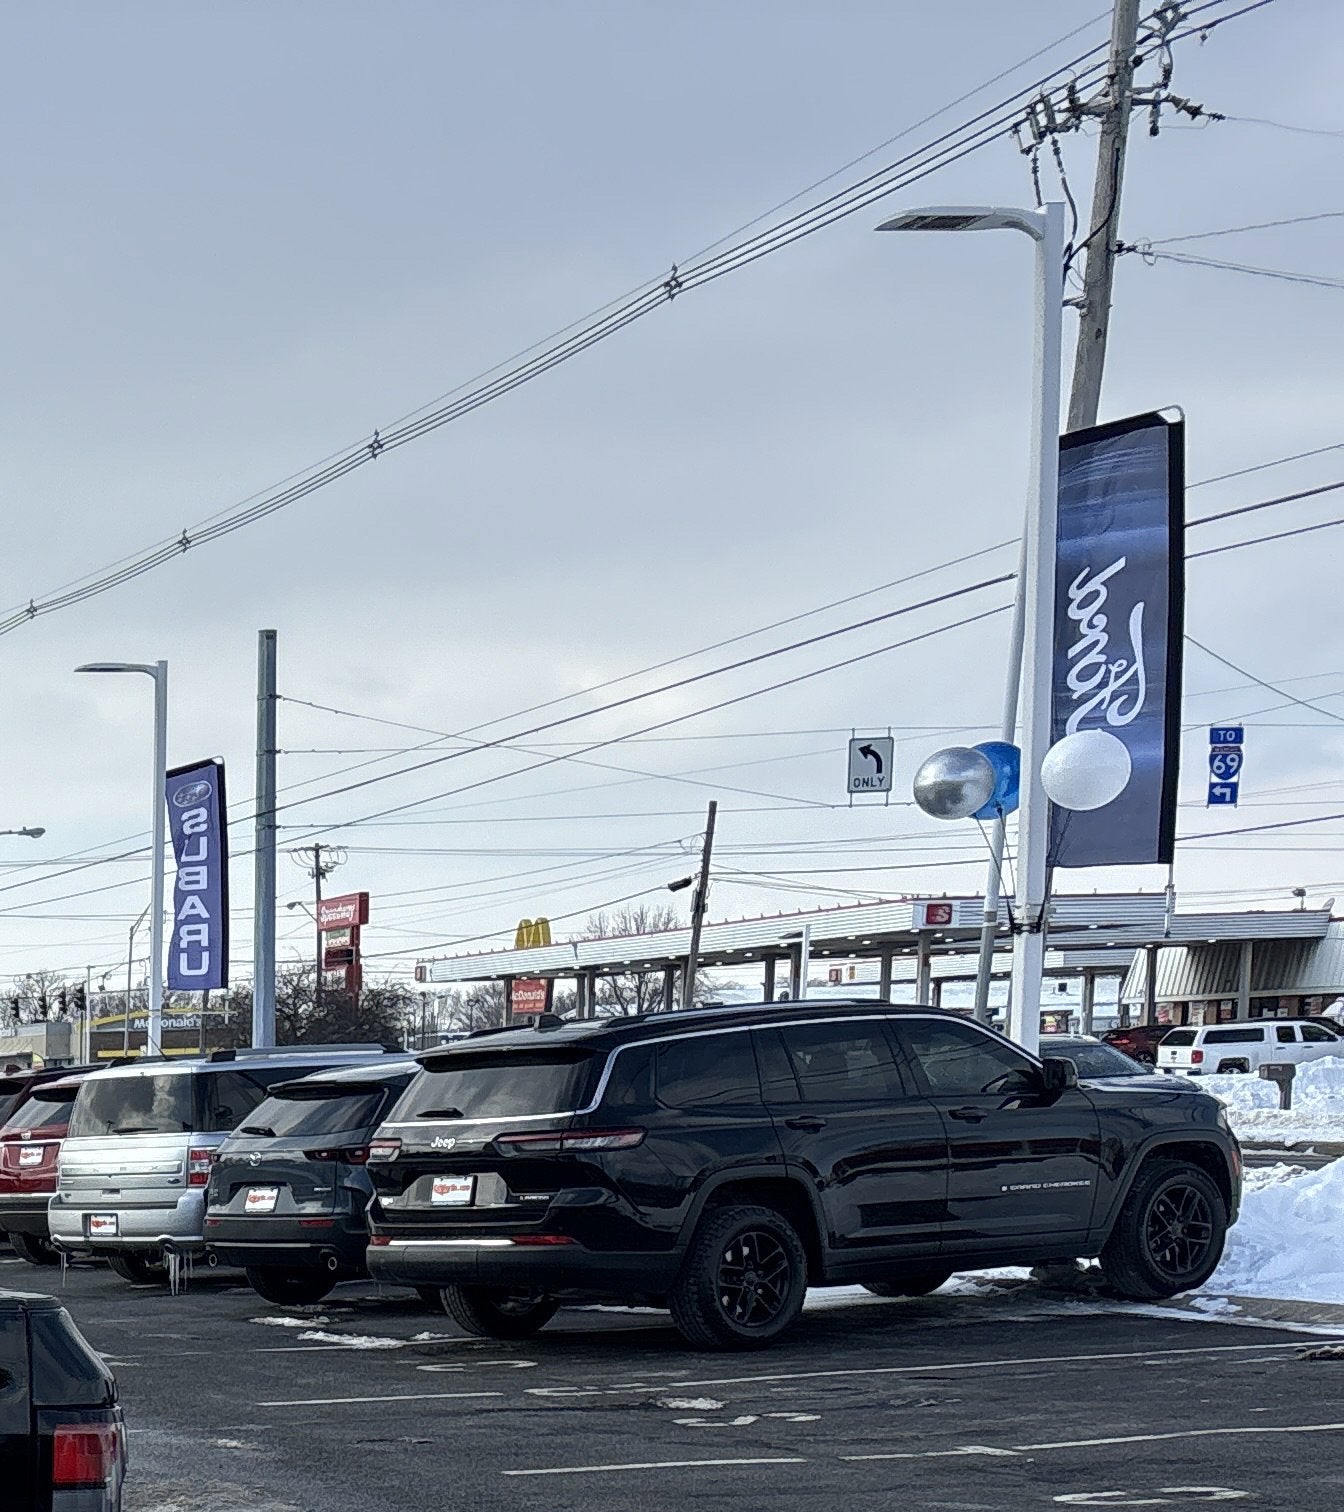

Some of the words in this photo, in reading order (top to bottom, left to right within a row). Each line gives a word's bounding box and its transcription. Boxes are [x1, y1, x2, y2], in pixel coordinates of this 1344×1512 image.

[1218, 730, 1236, 742] TO
[1213, 753, 1240, 775] 69
[853, 776, 886, 788] ONLY
[133, 1015, 202, 1029] Mconald's
[431, 1136, 456, 1150] Jeep
